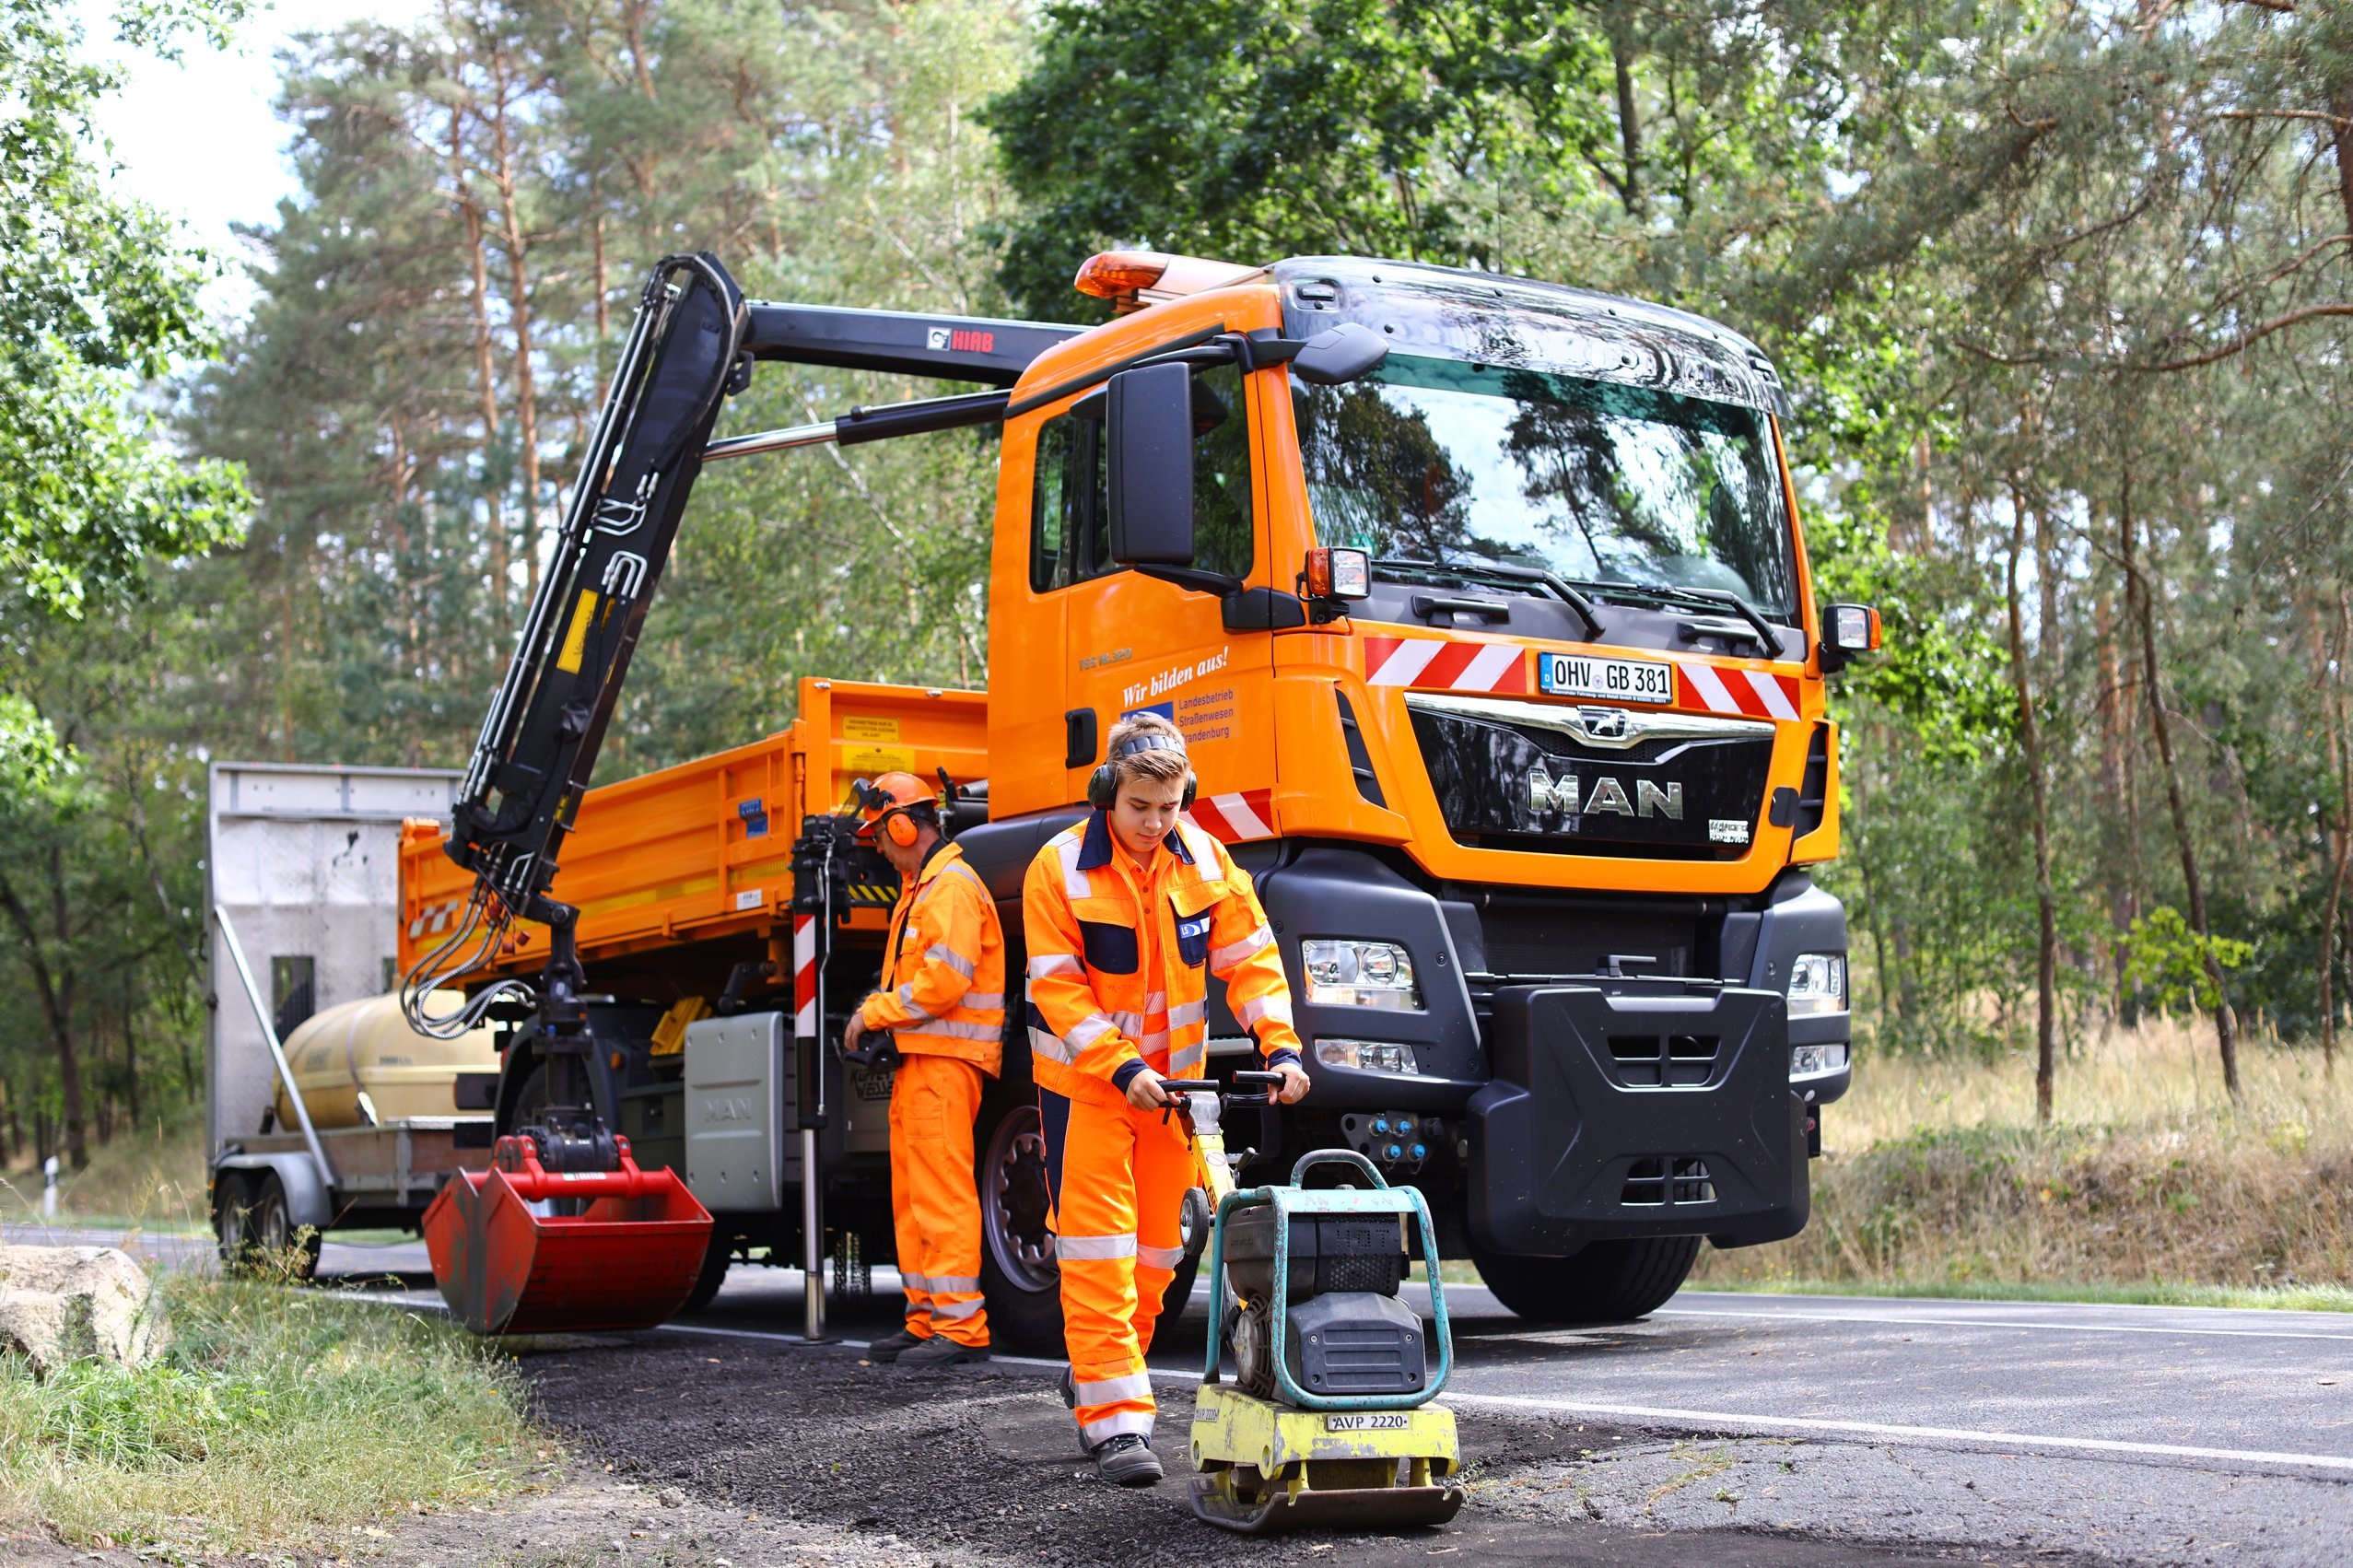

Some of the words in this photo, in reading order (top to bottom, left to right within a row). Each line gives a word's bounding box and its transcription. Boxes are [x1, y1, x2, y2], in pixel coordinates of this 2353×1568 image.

[952, 330, 994, 353] HIAB
[1122, 683, 1148, 708] Wir
[1150, 666, 1194, 697] bilden
[1197, 645, 1230, 677] aus!
[1544, 673, 1551, 683] D
[1554, 660, 1591, 687] OHV
[1606, 664, 1630, 690] GB
[1633, 667, 1668, 694] 381
[1178, 689, 1234, 710] Landesbetrieb
[1179, 708, 1234, 728] Straßenwesen
[1528, 771, 1683, 821] MAN
[1181, 925, 1189, 936] LS
[704, 1096, 753, 1122] MAN
[1336, 1229, 1390, 1248] HOT
[1334, 1416, 1364, 1430] AVP
[1370, 1415, 1403, 1428] 2220
